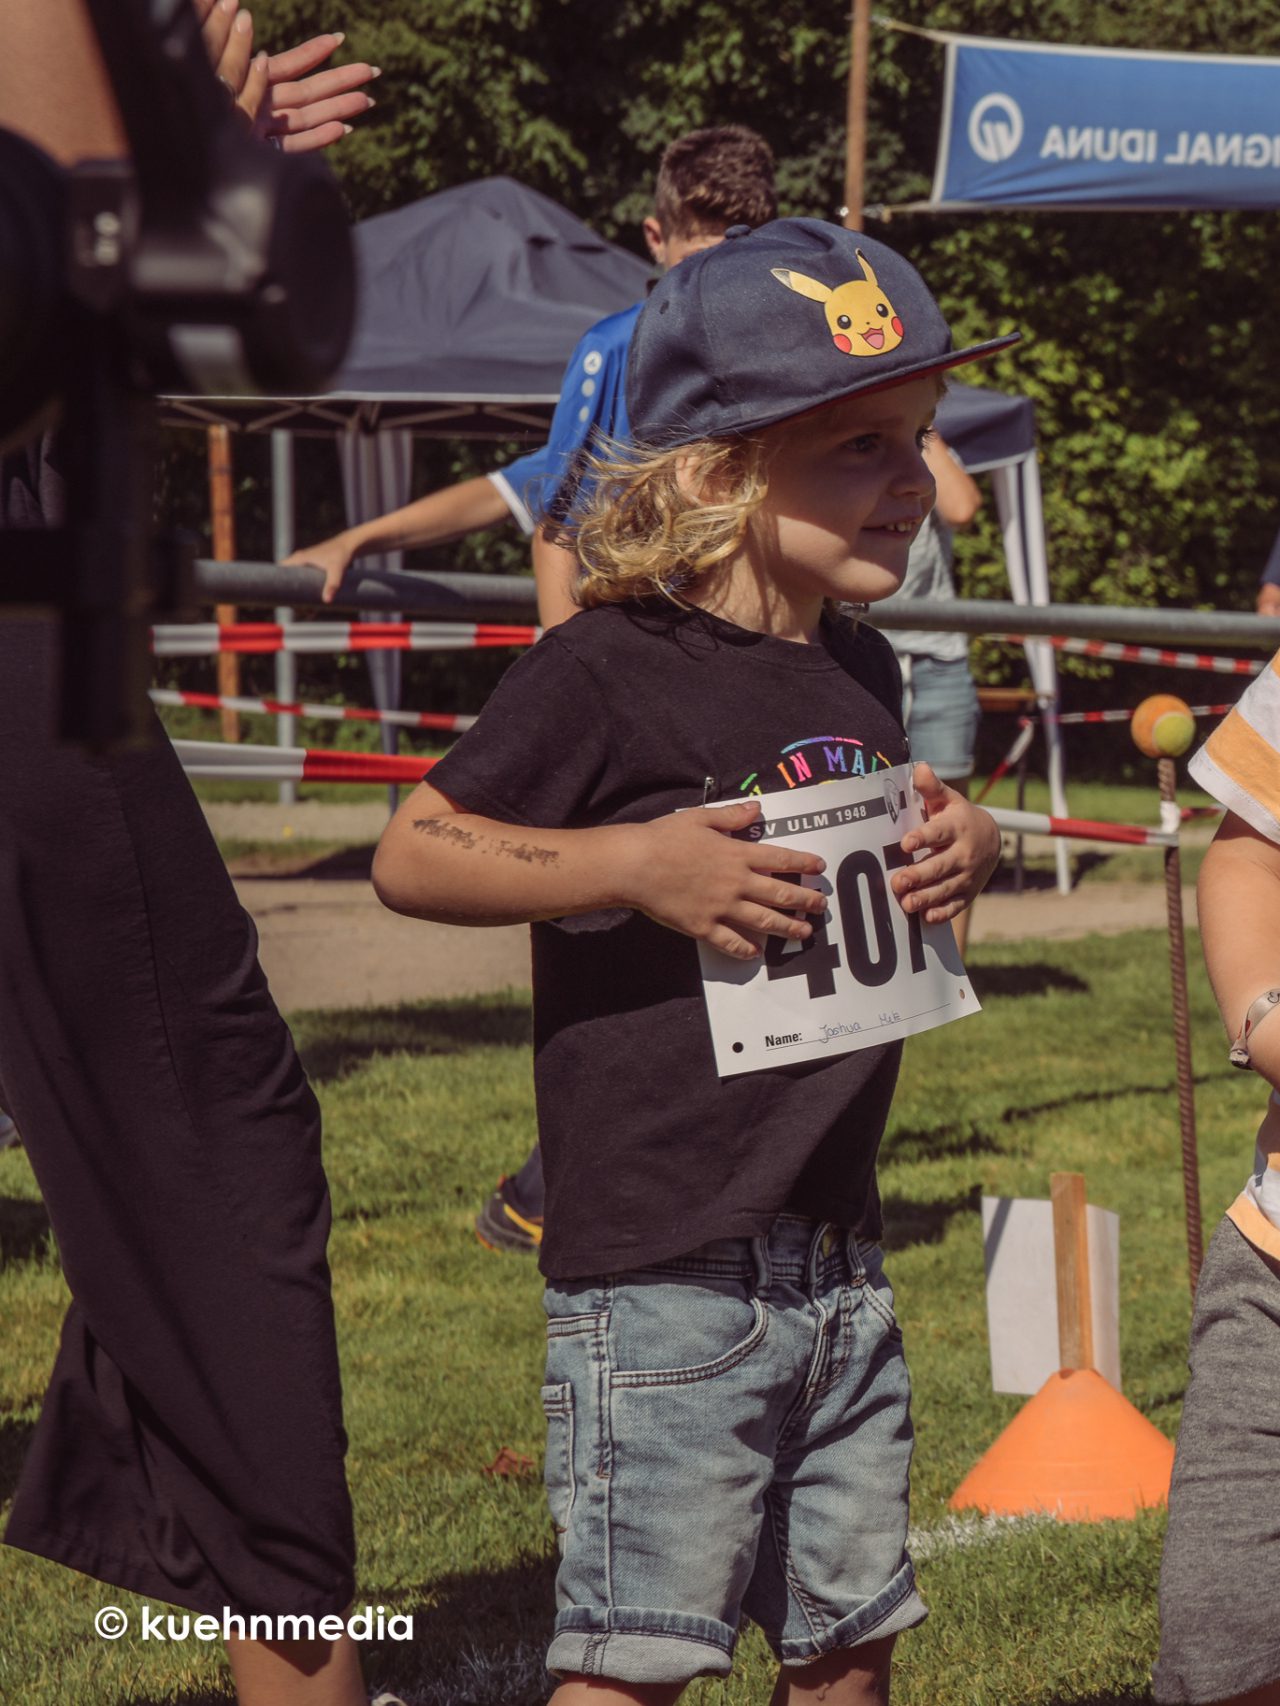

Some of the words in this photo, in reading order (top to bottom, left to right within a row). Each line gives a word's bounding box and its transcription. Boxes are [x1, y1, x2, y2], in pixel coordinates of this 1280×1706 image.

[750, 822, 776, 839] SV
[787, 815, 829, 832] ULM
[835, 805, 867, 823] 1948
[765, 1032, 803, 1047] Name:
